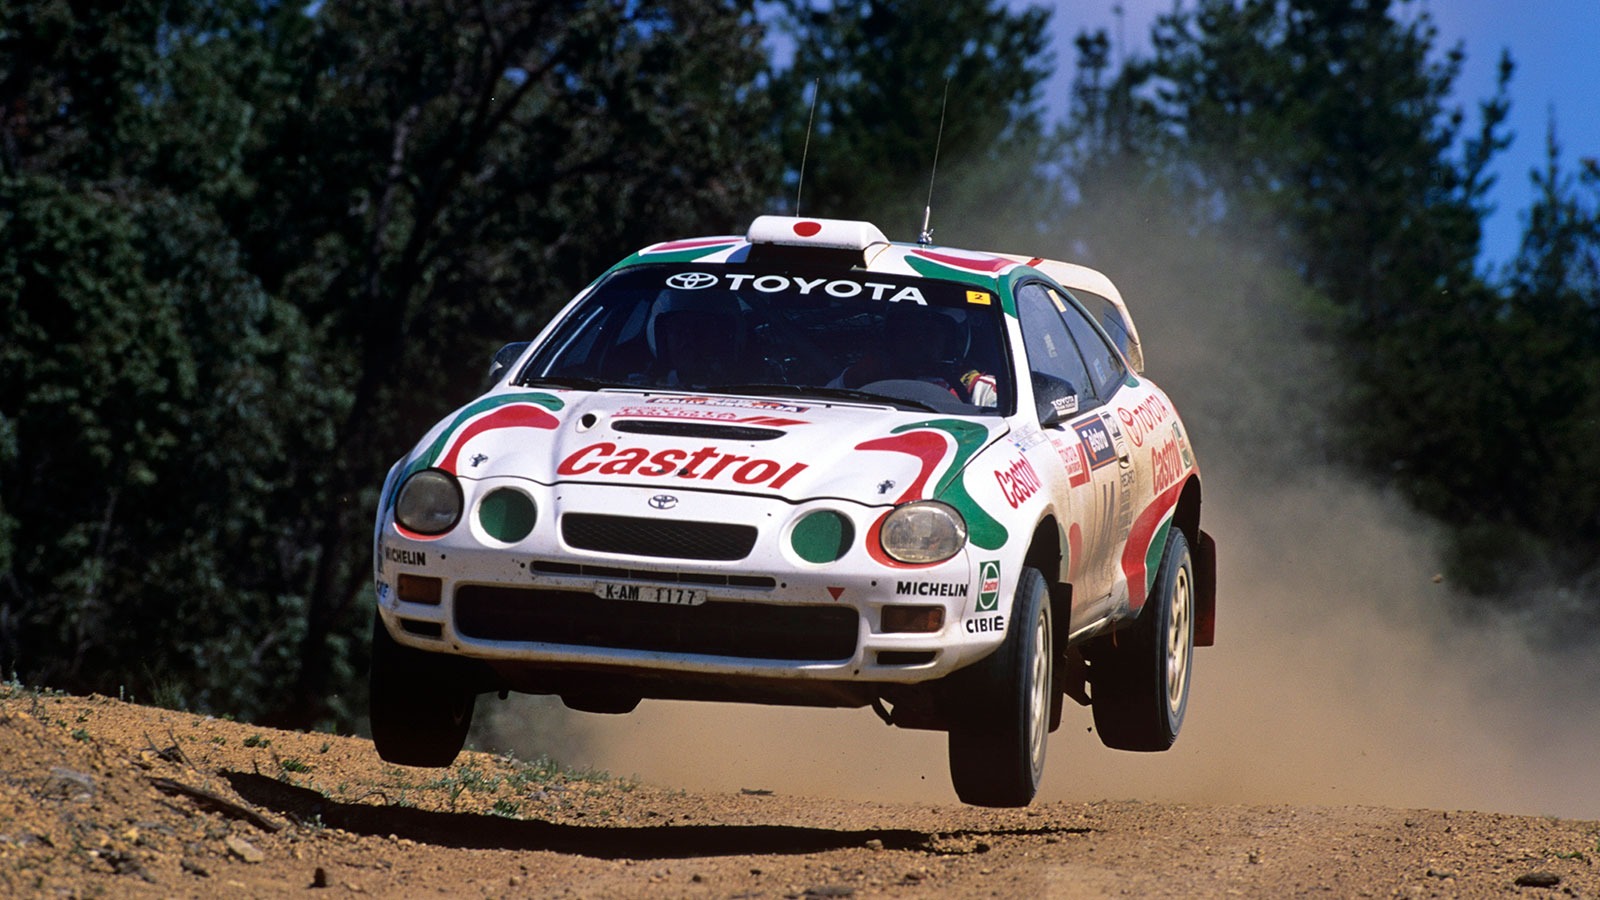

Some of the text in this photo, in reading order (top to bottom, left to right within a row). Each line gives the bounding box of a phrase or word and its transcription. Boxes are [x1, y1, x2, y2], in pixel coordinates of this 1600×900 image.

[725, 273, 928, 306] TOYOTA
[974, 293, 983, 301] 2
[1133, 393, 1169, 434] TOYOTA
[556, 442, 809, 490] Castrol
[994, 450, 1042, 509] Castrol
[1151, 430, 1183, 496] Castrol
[606, 585, 695, 604] K-AM 1177
[896, 581, 968, 597] MICHELIN
